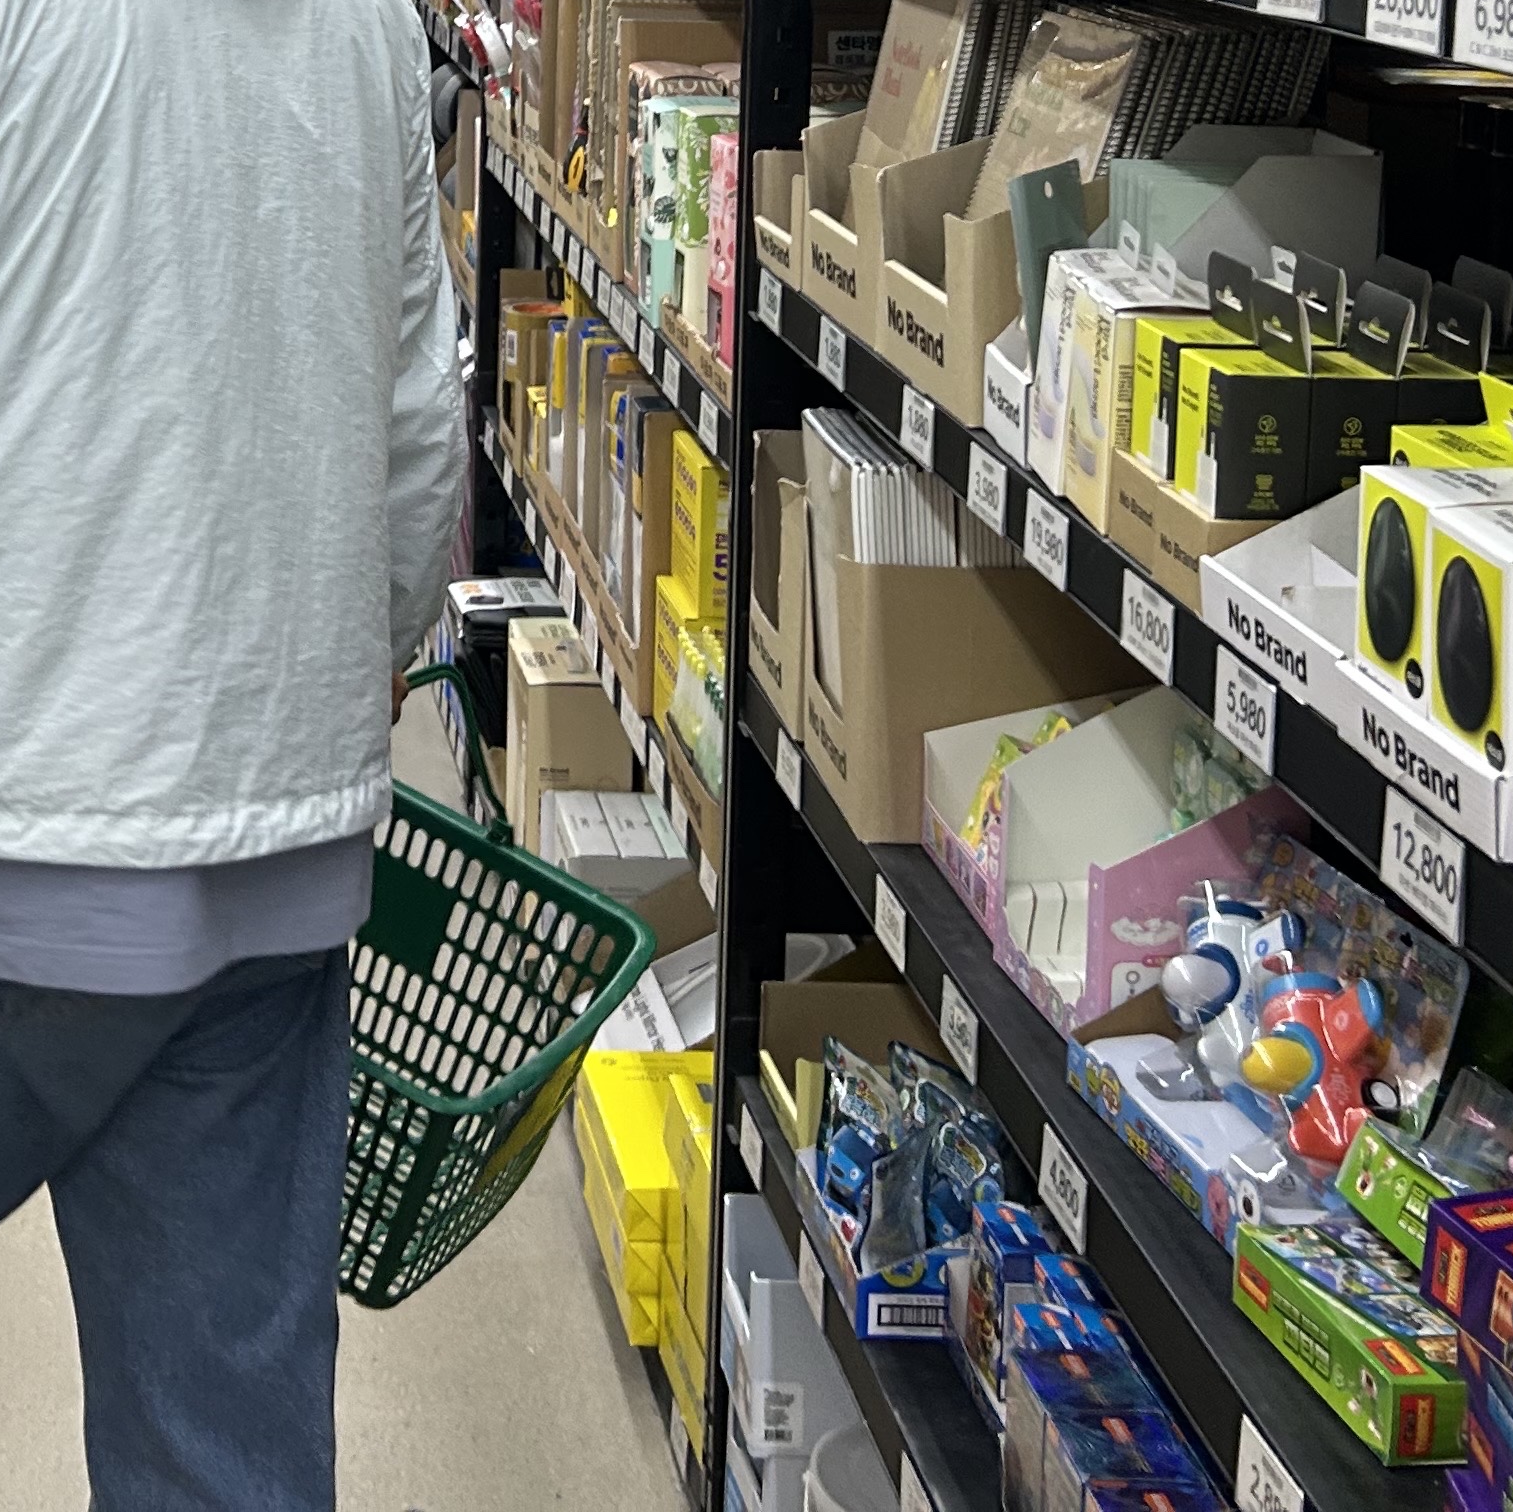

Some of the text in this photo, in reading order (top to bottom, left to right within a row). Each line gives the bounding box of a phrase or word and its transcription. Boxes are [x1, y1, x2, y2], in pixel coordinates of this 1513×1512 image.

[772, 237, 790, 269] Brand
[811, 242, 824, 274] No
[825, 254, 857, 300] Brand
[887, 298, 945, 369] No Brand
[987, 376, 1022, 430] No Brand
[1119, 488, 1154, 528] No Brand
[1160, 531, 1199, 574] No Brand
[1126, 594, 1171, 655] 16,800
[1227, 598, 1308, 686] No Brand
[1226, 687, 1267, 741] 5,980
[1362, 707, 1461, 812] No Brand
[1392, 821, 1457, 905] 12,800
